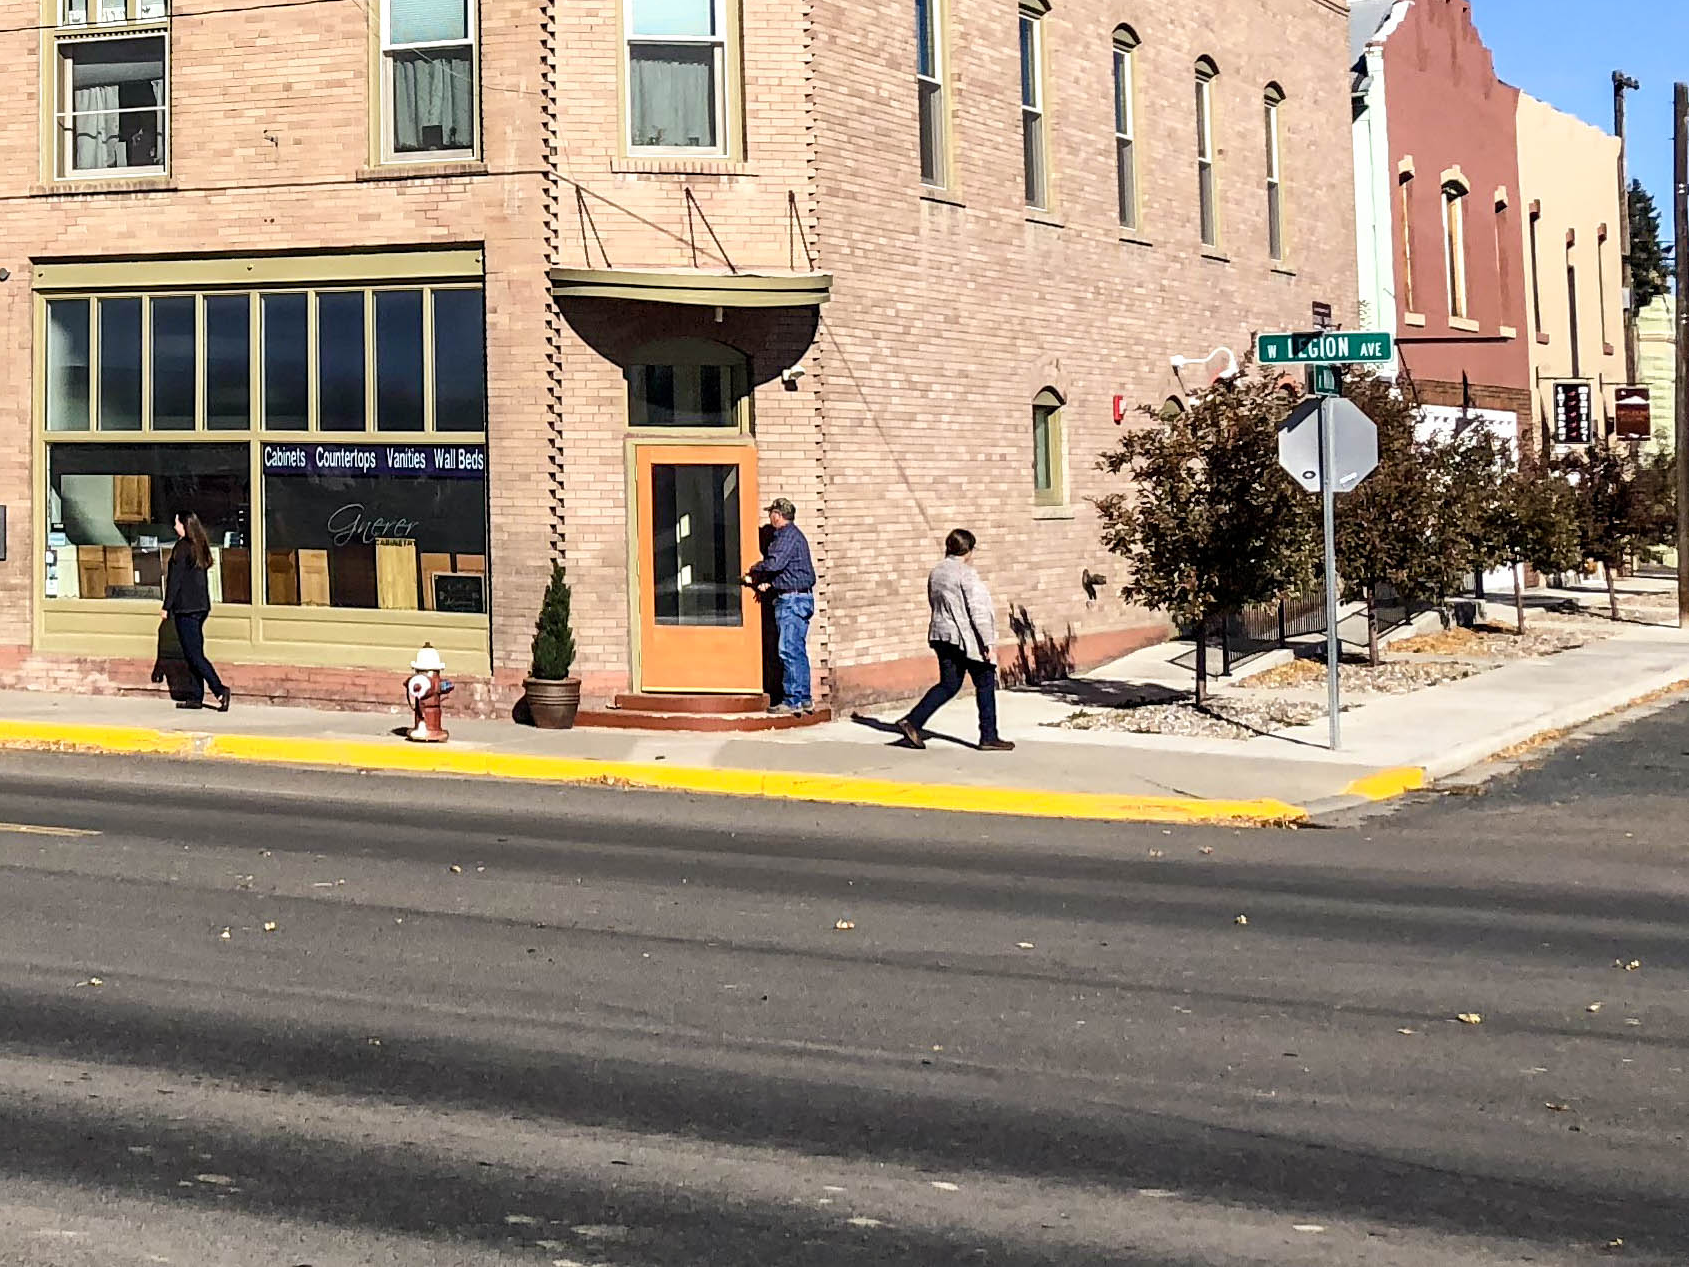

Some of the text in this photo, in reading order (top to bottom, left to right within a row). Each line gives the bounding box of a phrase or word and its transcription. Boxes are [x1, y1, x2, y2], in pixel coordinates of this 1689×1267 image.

[1267, 336, 1382, 359] W LEGION AVE
[264, 446, 484, 473] Cabinets Countertops Vanities Wall Beds
